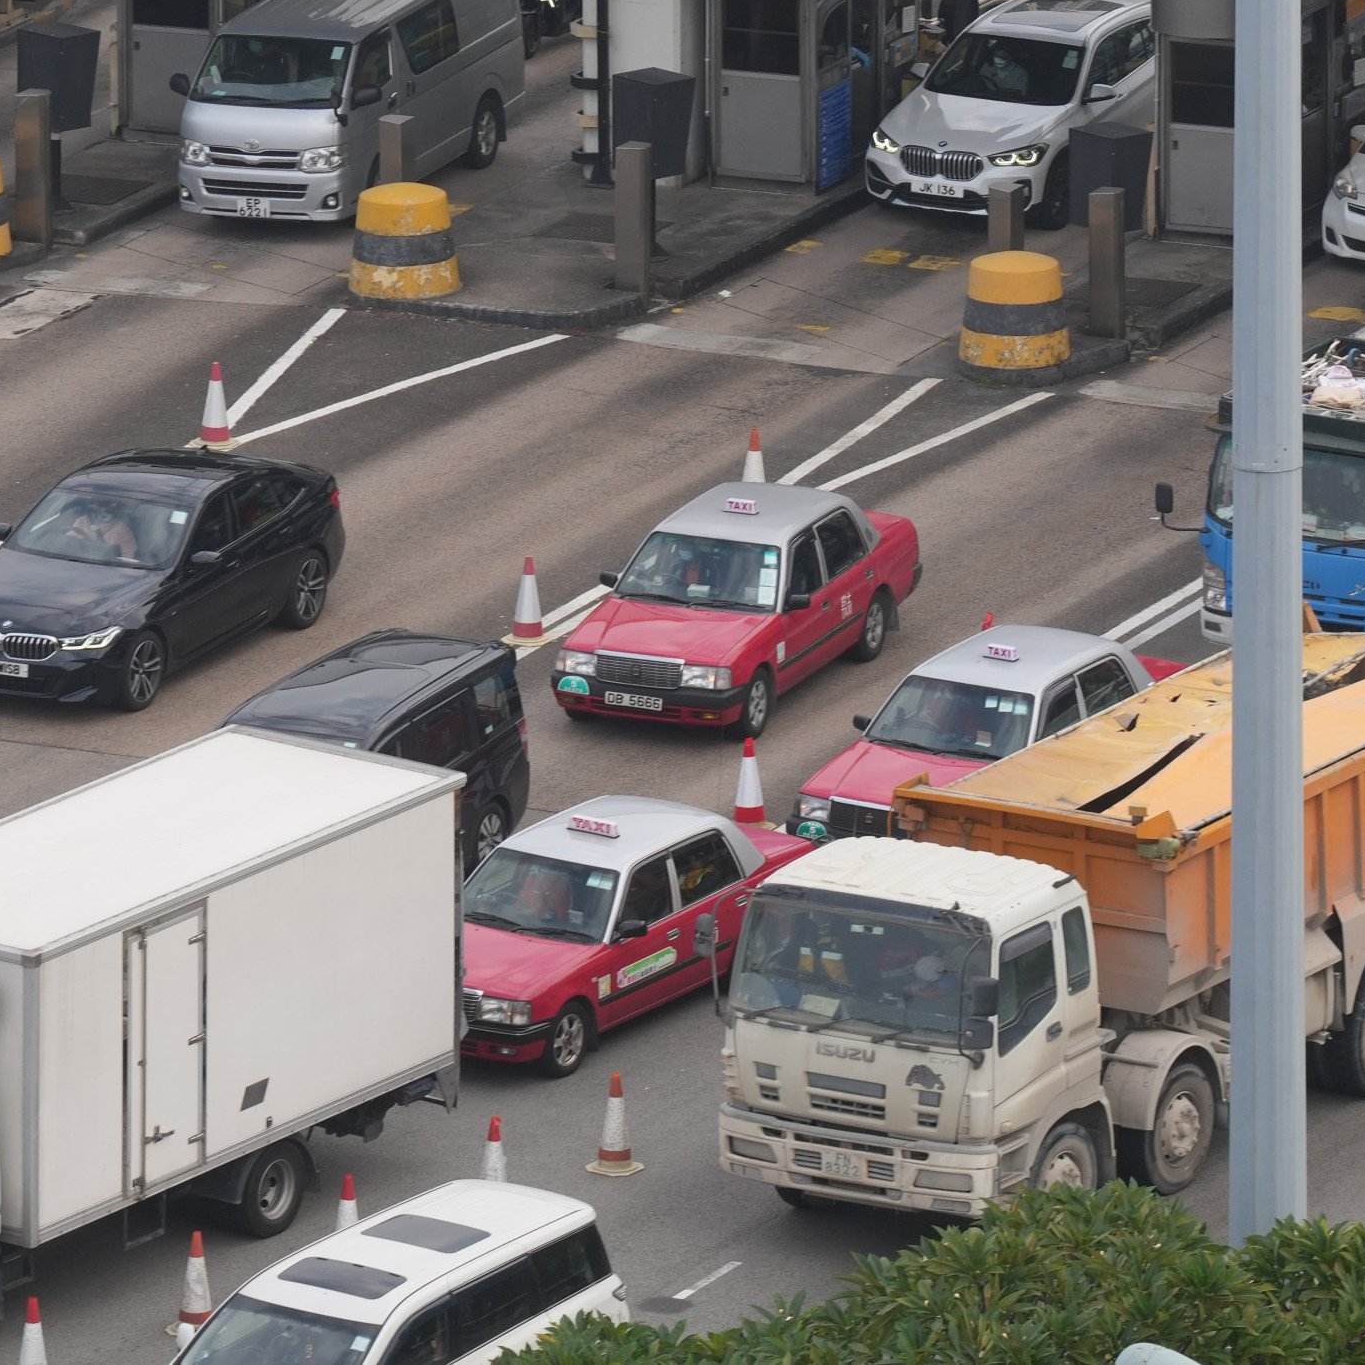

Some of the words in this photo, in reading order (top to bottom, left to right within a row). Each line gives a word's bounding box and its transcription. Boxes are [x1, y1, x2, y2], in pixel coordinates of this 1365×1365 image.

[919, 184, 933, 194] JK
[937, 185, 955, 196] 136
[246, 198, 260, 208] EP
[239, 206, 267, 218] 6221
[728, 501, 753, 511] TAXI
[988, 647, 1012, 658] TAXI
[607, 692, 623, 704] DB
[629, 695, 661, 709] 5666
[572, 818, 611, 834] TAXI
[815, 1042, 875, 1063] ISUZU
[825, 1162, 860, 1177] 8322
